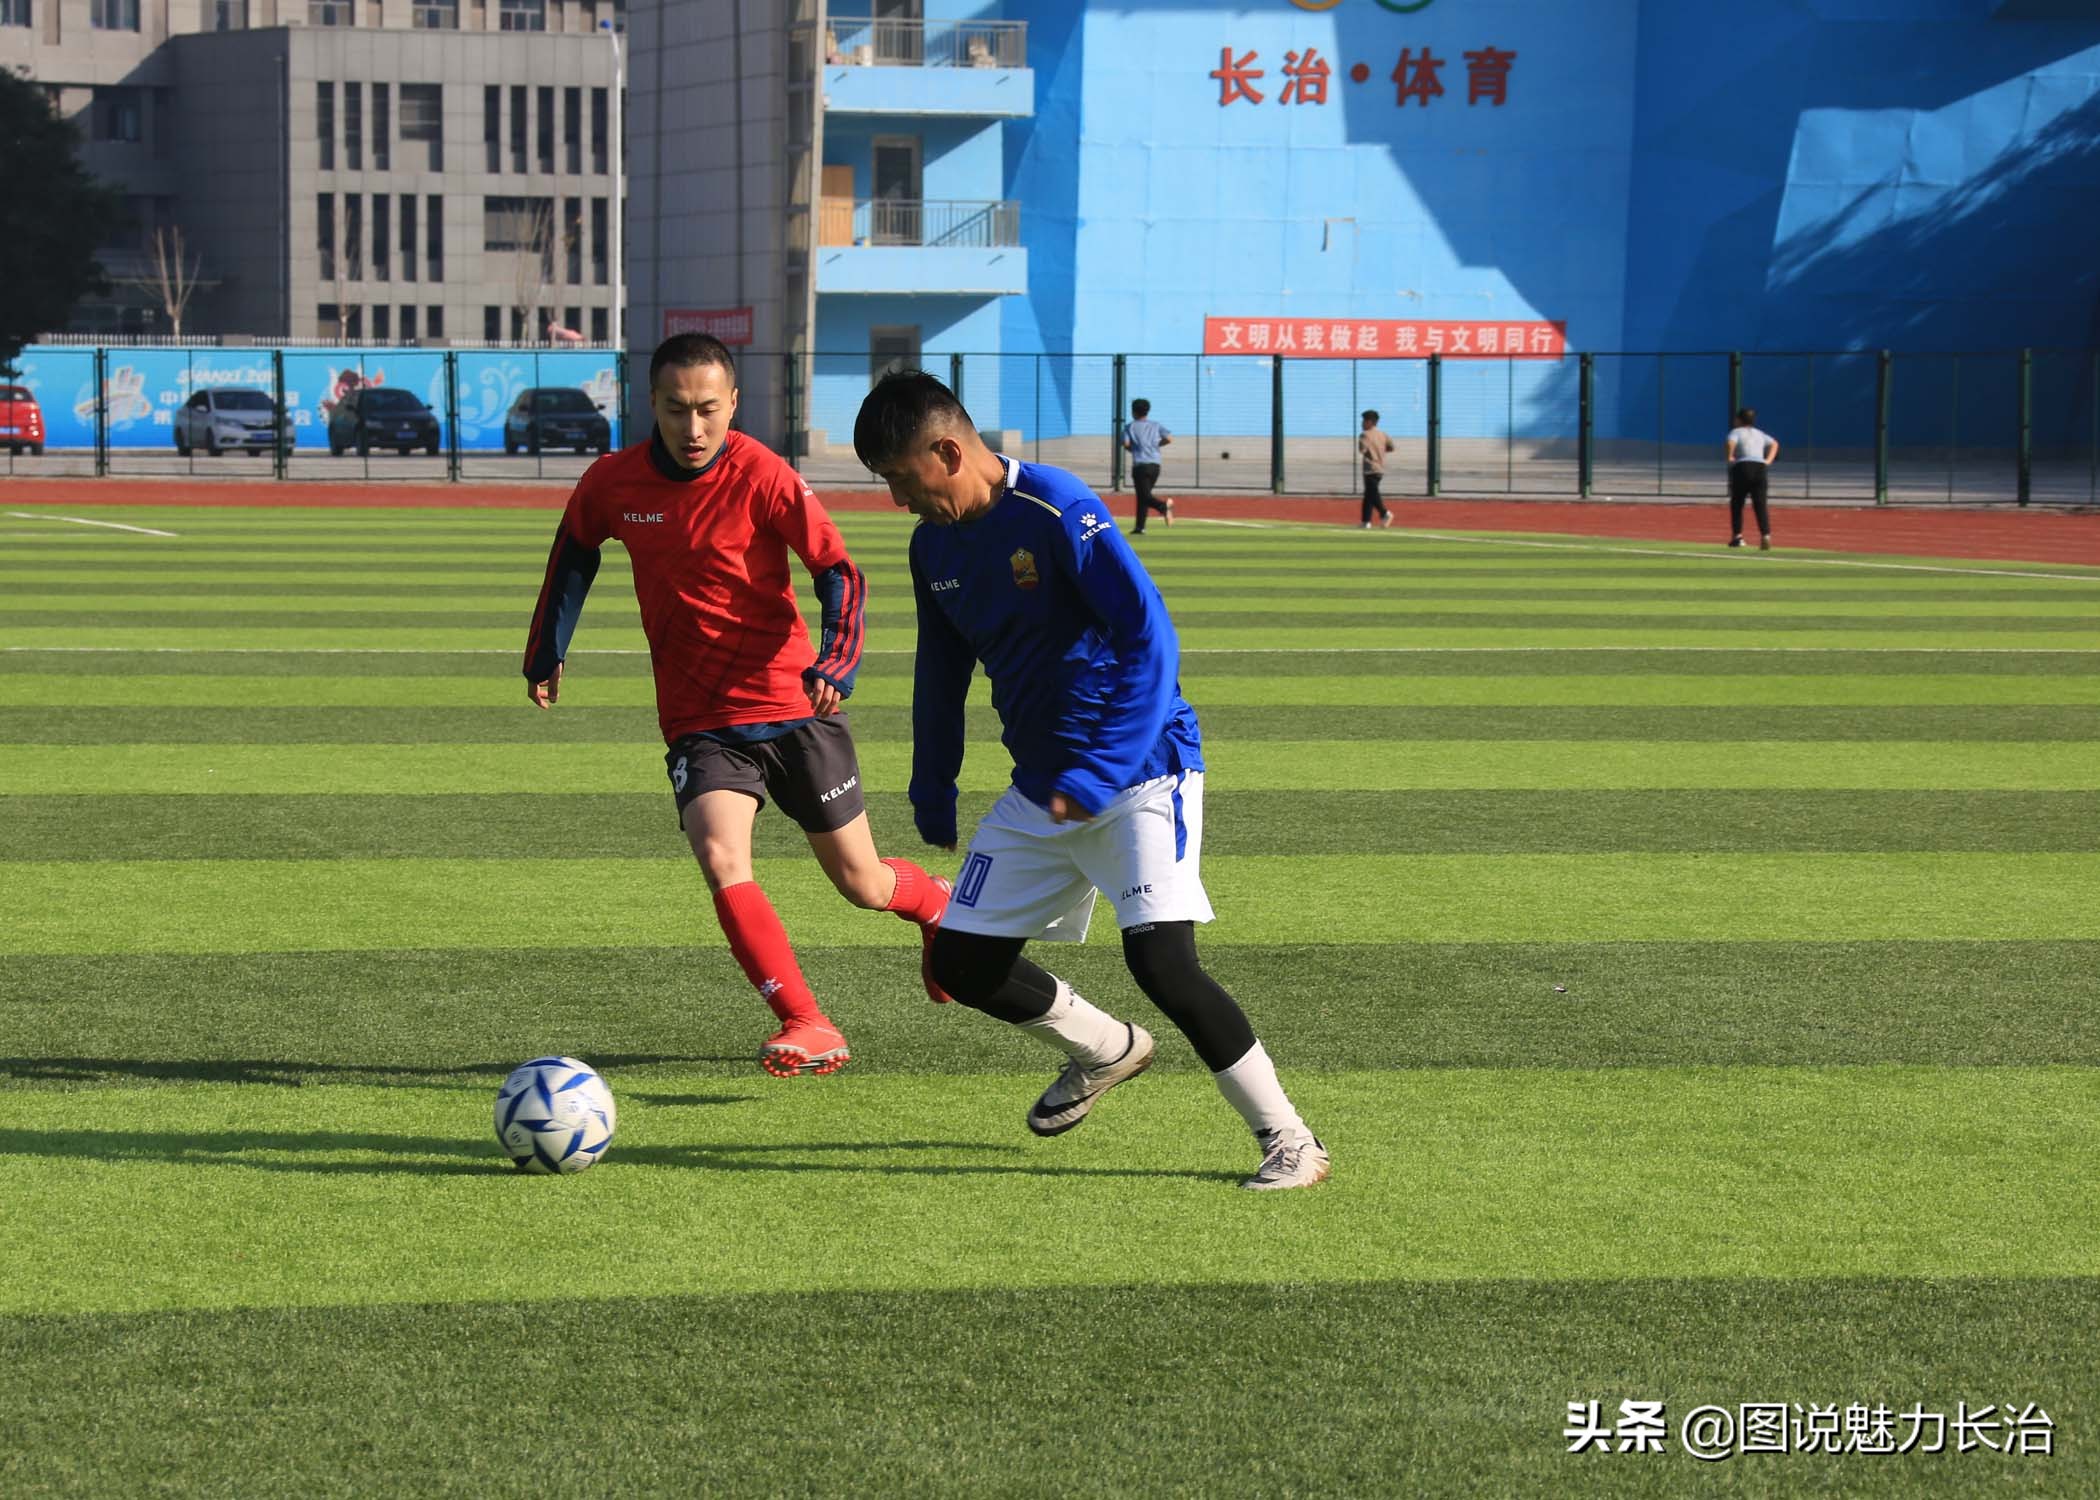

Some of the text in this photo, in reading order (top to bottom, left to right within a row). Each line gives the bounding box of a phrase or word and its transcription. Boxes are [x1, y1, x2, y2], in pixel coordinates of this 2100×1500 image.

[1219, 323, 1553, 353] 文明从我做起 我与文明同行
[623, 512, 664, 523] KELME
[1080, 521, 1112, 542] KELME
[820, 775, 857, 803] KELME
